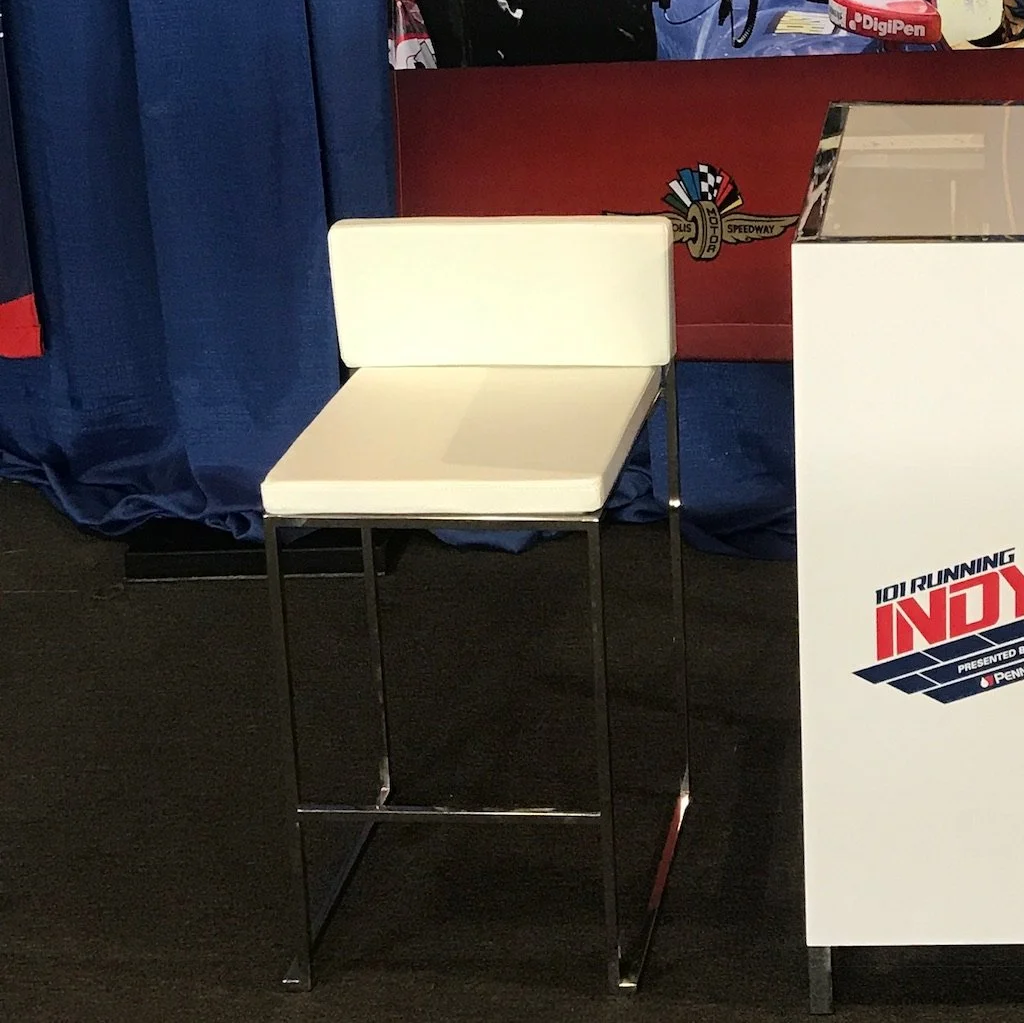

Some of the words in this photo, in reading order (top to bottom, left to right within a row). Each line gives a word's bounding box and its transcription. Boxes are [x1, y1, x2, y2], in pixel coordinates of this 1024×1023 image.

[862, 14, 926, 37] DigiPen
[706, 207, 717, 253] MOTOR
[727, 223, 775, 235] SPEEDWAY
[875, 581, 906, 605] 101
[910, 547, 1016, 595] RUNNING
[957, 649, 1017, 674] PRESENTED
